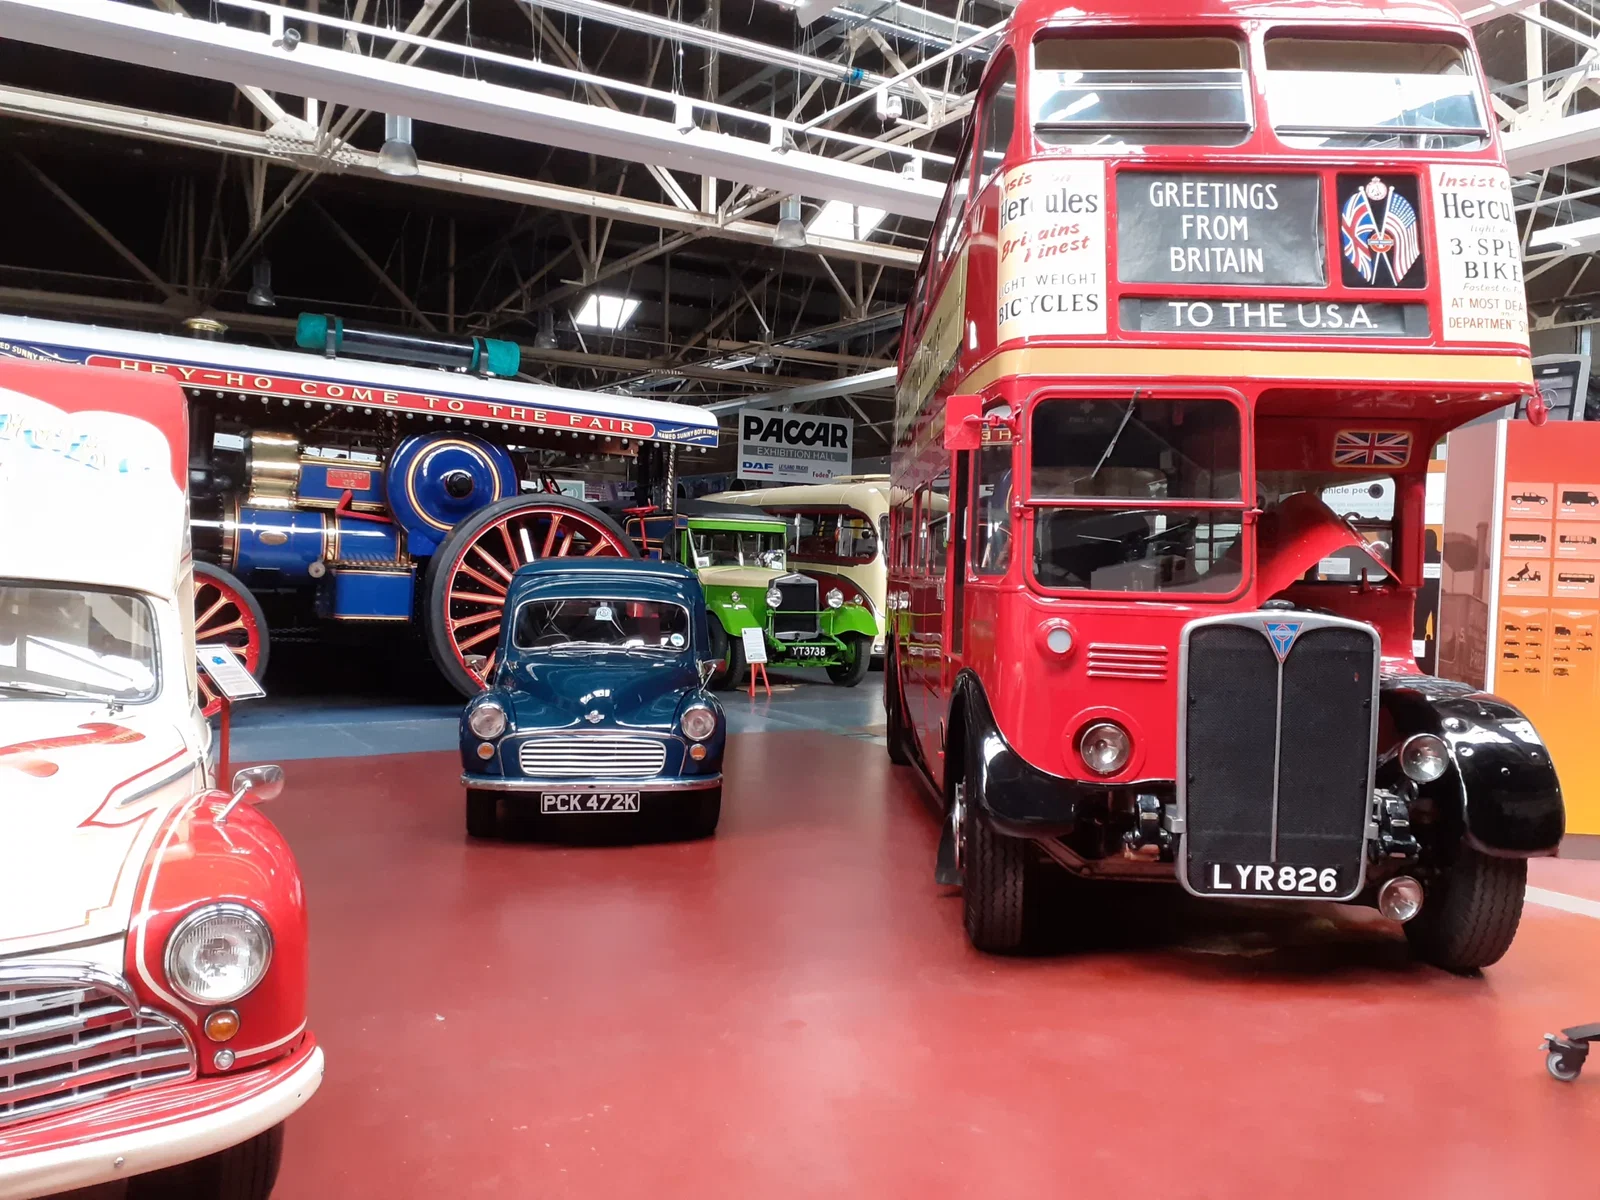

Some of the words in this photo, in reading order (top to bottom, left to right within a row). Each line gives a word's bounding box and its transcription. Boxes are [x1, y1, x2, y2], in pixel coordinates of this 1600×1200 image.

[1438, 171, 1495, 188] Insist
[1000, 187, 1098, 230] Herules
[1150, 181, 1279, 211] GREETINGS
[1182, 214, 1249, 241] FROM
[1001, 223, 1080, 263] Briains
[1170, 246, 1264, 273] BRITAIN
[1036, 272, 1097, 285] WEIGHT
[999, 293, 1098, 326] BICYCLES
[1168, 302, 1213, 328] TO
[1230, 302, 1285, 328] THE
[1298, 303, 1379, 328] U.S.A.
[1451, 297, 1464, 308] AT
[1469, 298, 1499, 310] MOST
[300, 382, 399, 405] COME
[423, 396, 465, 412] TO
[488, 405, 548, 422] THE
[570, 416, 635, 433] FAIR
[743, 415, 849, 449] PACCAR
[742, 461, 774, 470] DAF
[756, 446, 811, 460] EXHIBITION
[812, 451, 836, 462] HALL
[1323, 486, 1349, 495] ehicle
[1352, 486, 1370, 496] peo
[792, 646, 826, 657] YT3738
[543, 793, 582, 812] PCK
[586, 793, 637, 811] 472K
[1212, 863, 1338, 893] LYR826
